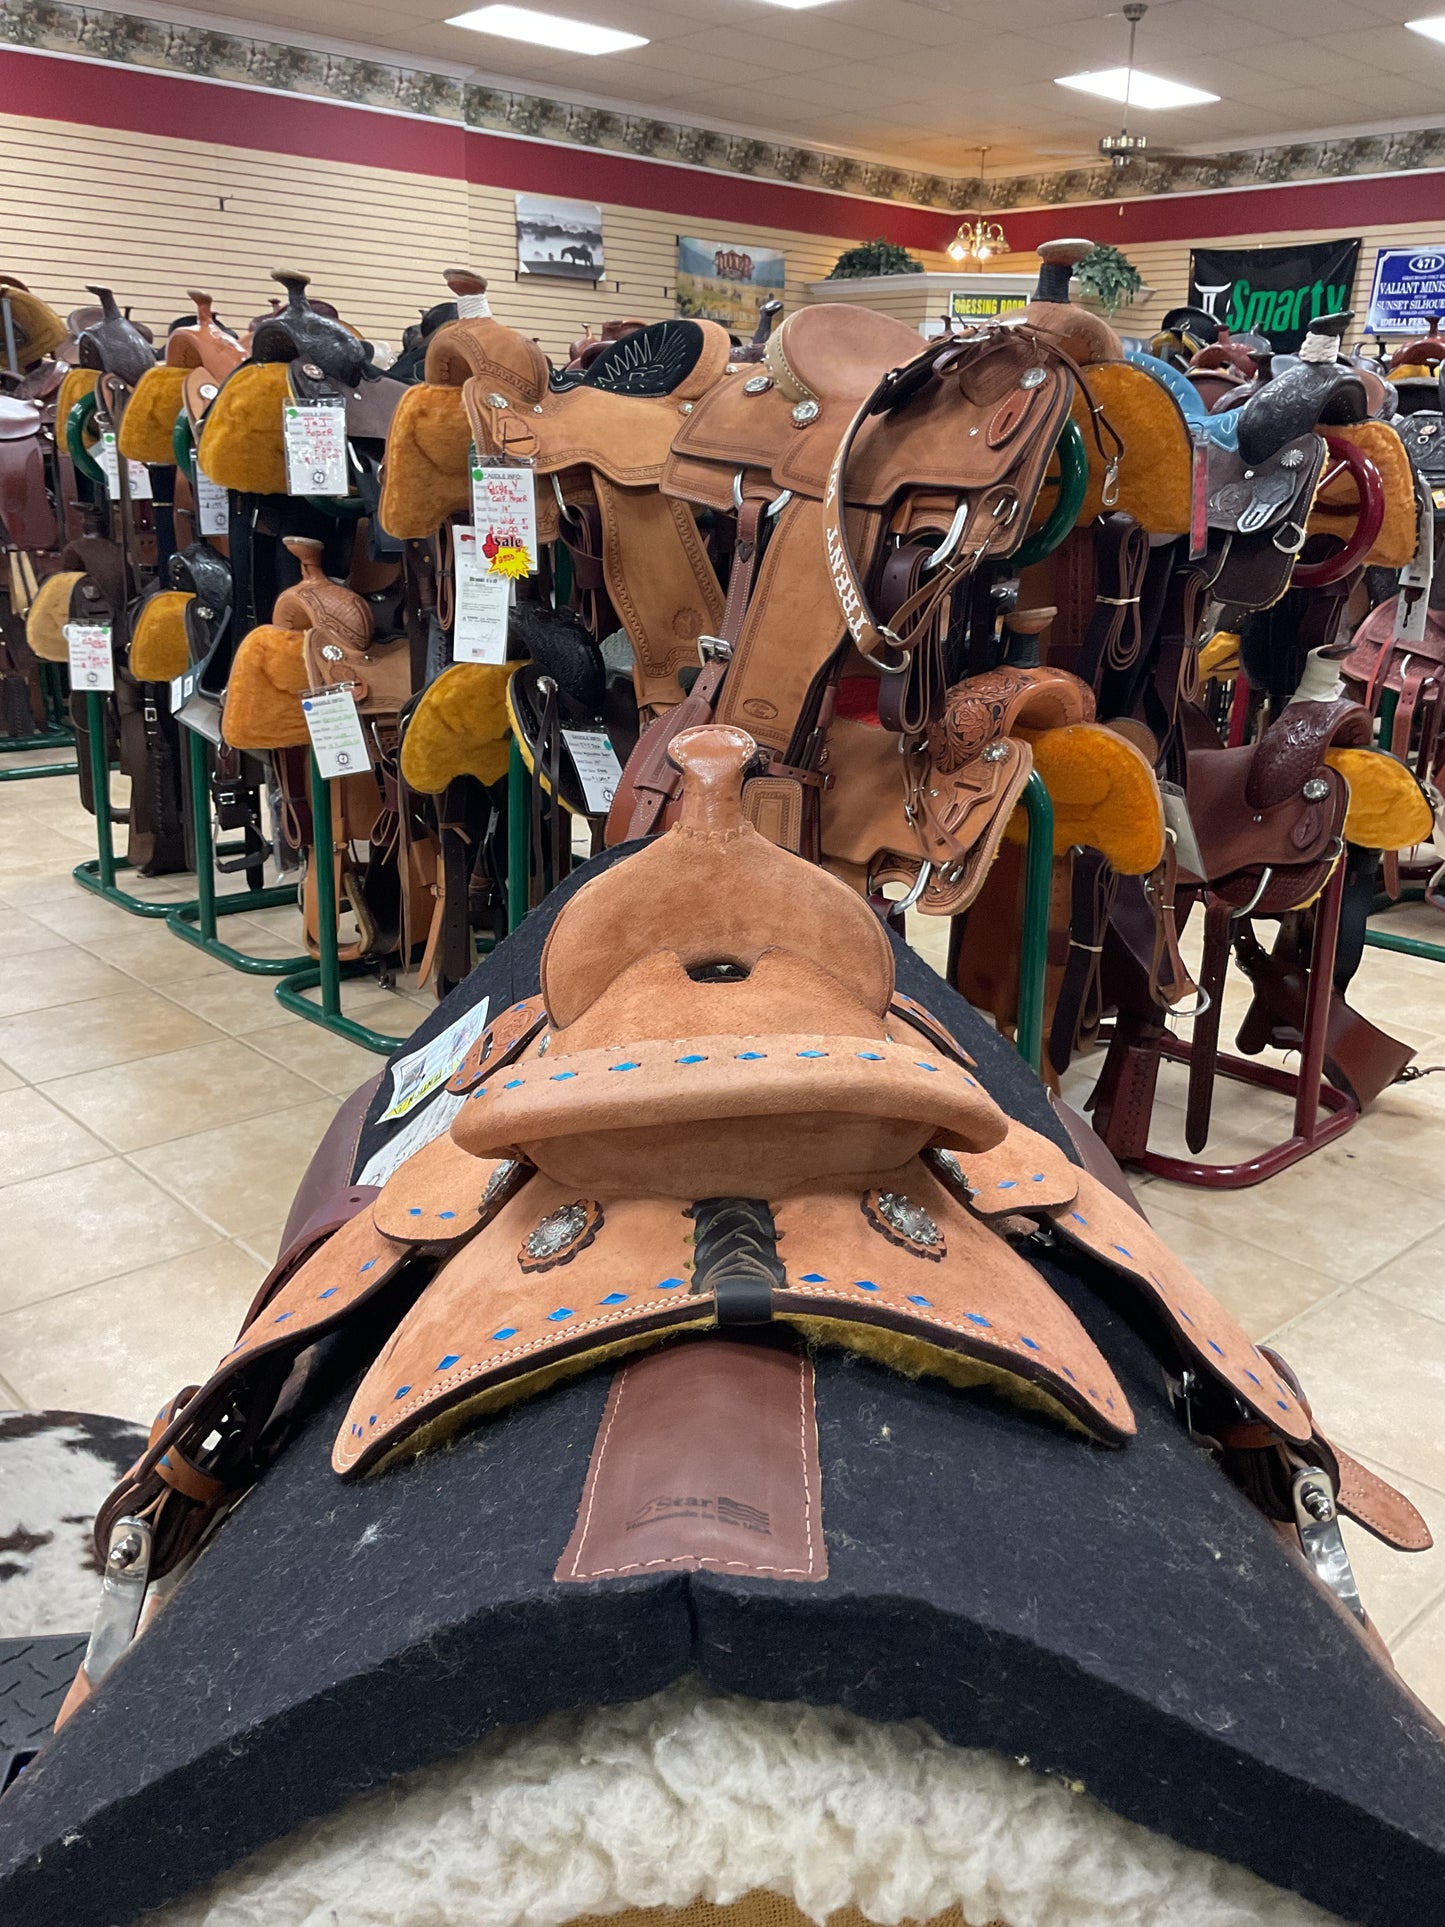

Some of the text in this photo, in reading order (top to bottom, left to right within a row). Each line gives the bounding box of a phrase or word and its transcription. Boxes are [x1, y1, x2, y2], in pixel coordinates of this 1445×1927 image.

[1416, 258, 1436, 269] 471
[1380, 281, 1420, 295] VALIANT
[954, 298, 998, 314] DRESSING
[1225, 279, 1347, 333] Smarty
[1376, 300, 1410, 311] SUNSET
[495, 536, 522, 547] sale
[826, 523, 871, 642] TRENT
